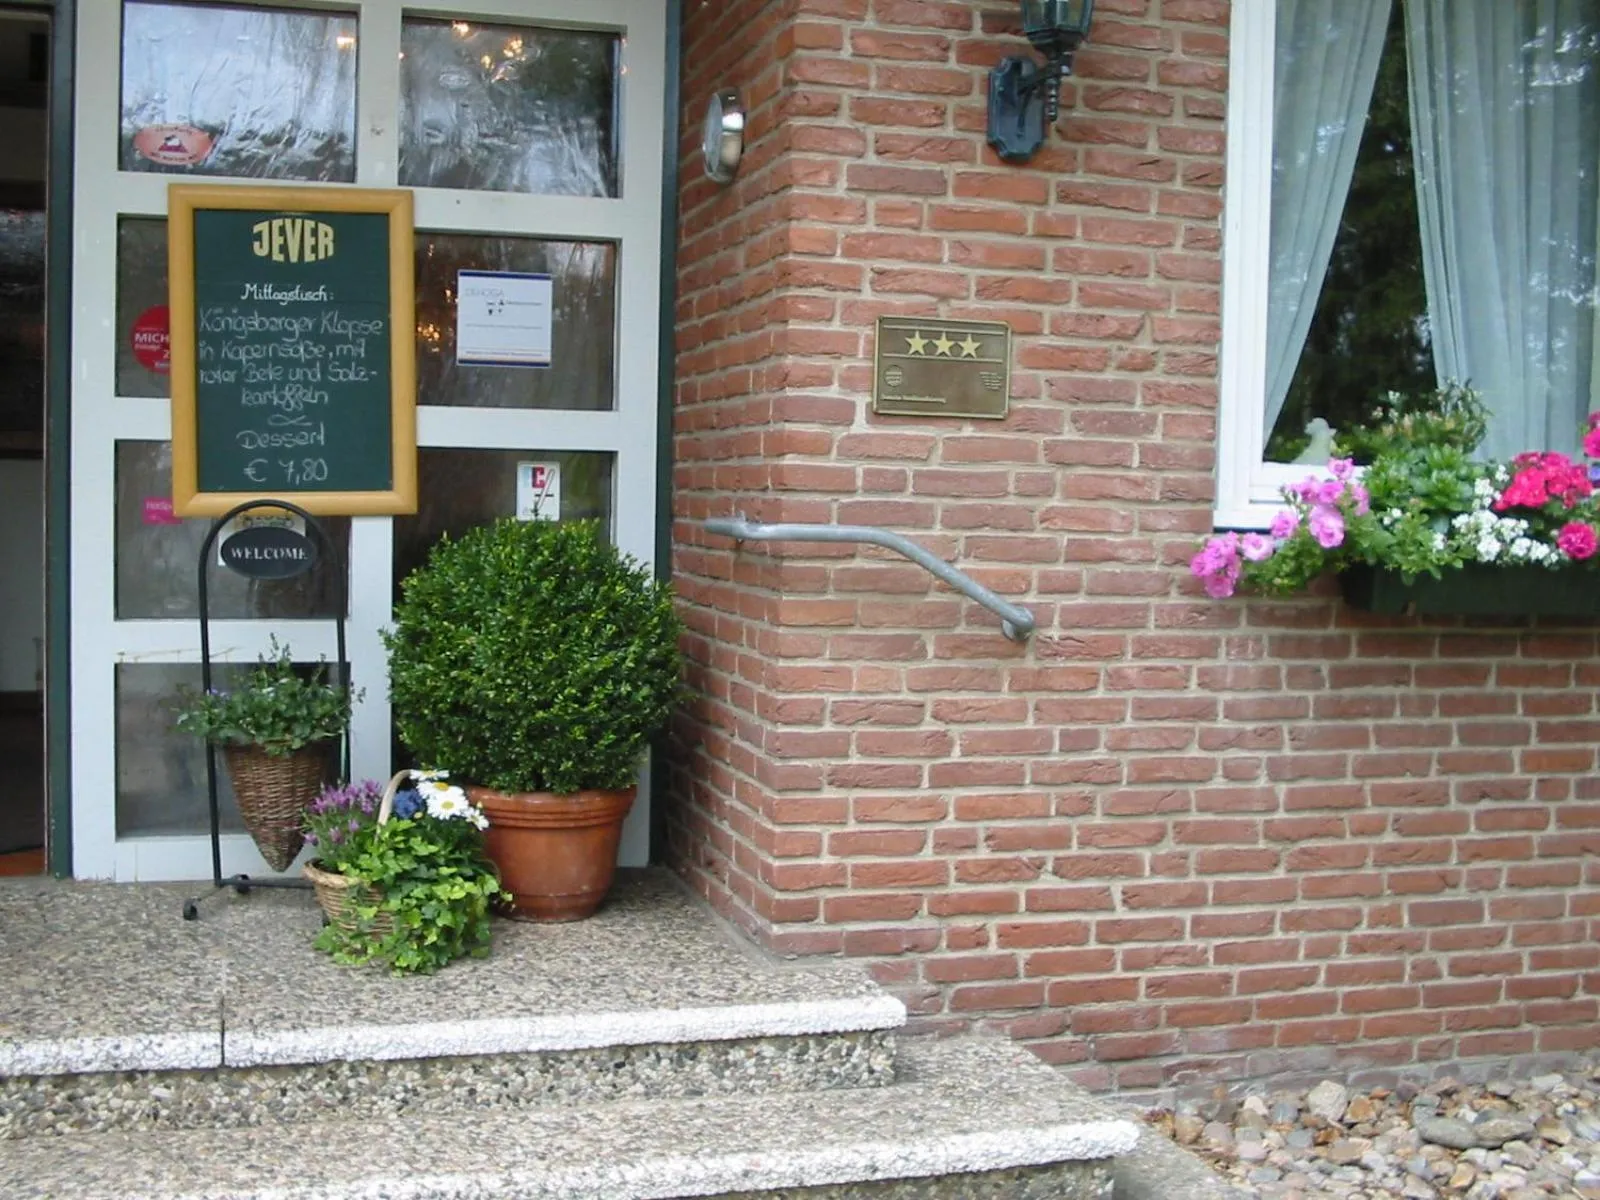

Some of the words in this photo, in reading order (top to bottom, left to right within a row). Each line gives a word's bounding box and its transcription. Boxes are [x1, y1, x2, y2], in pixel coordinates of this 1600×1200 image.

[253, 218, 334, 263] JEVER
[240, 283, 334, 305] Mittagstisch:
[199, 341, 214, 360] in
[335, 340, 366, 358] mit
[288, 361, 321, 382] und
[235, 422, 325, 449] Dessert
[243, 458, 269, 482] €
[278, 458, 329, 485] 7,80
[231, 546, 309, 560] WELCOME
